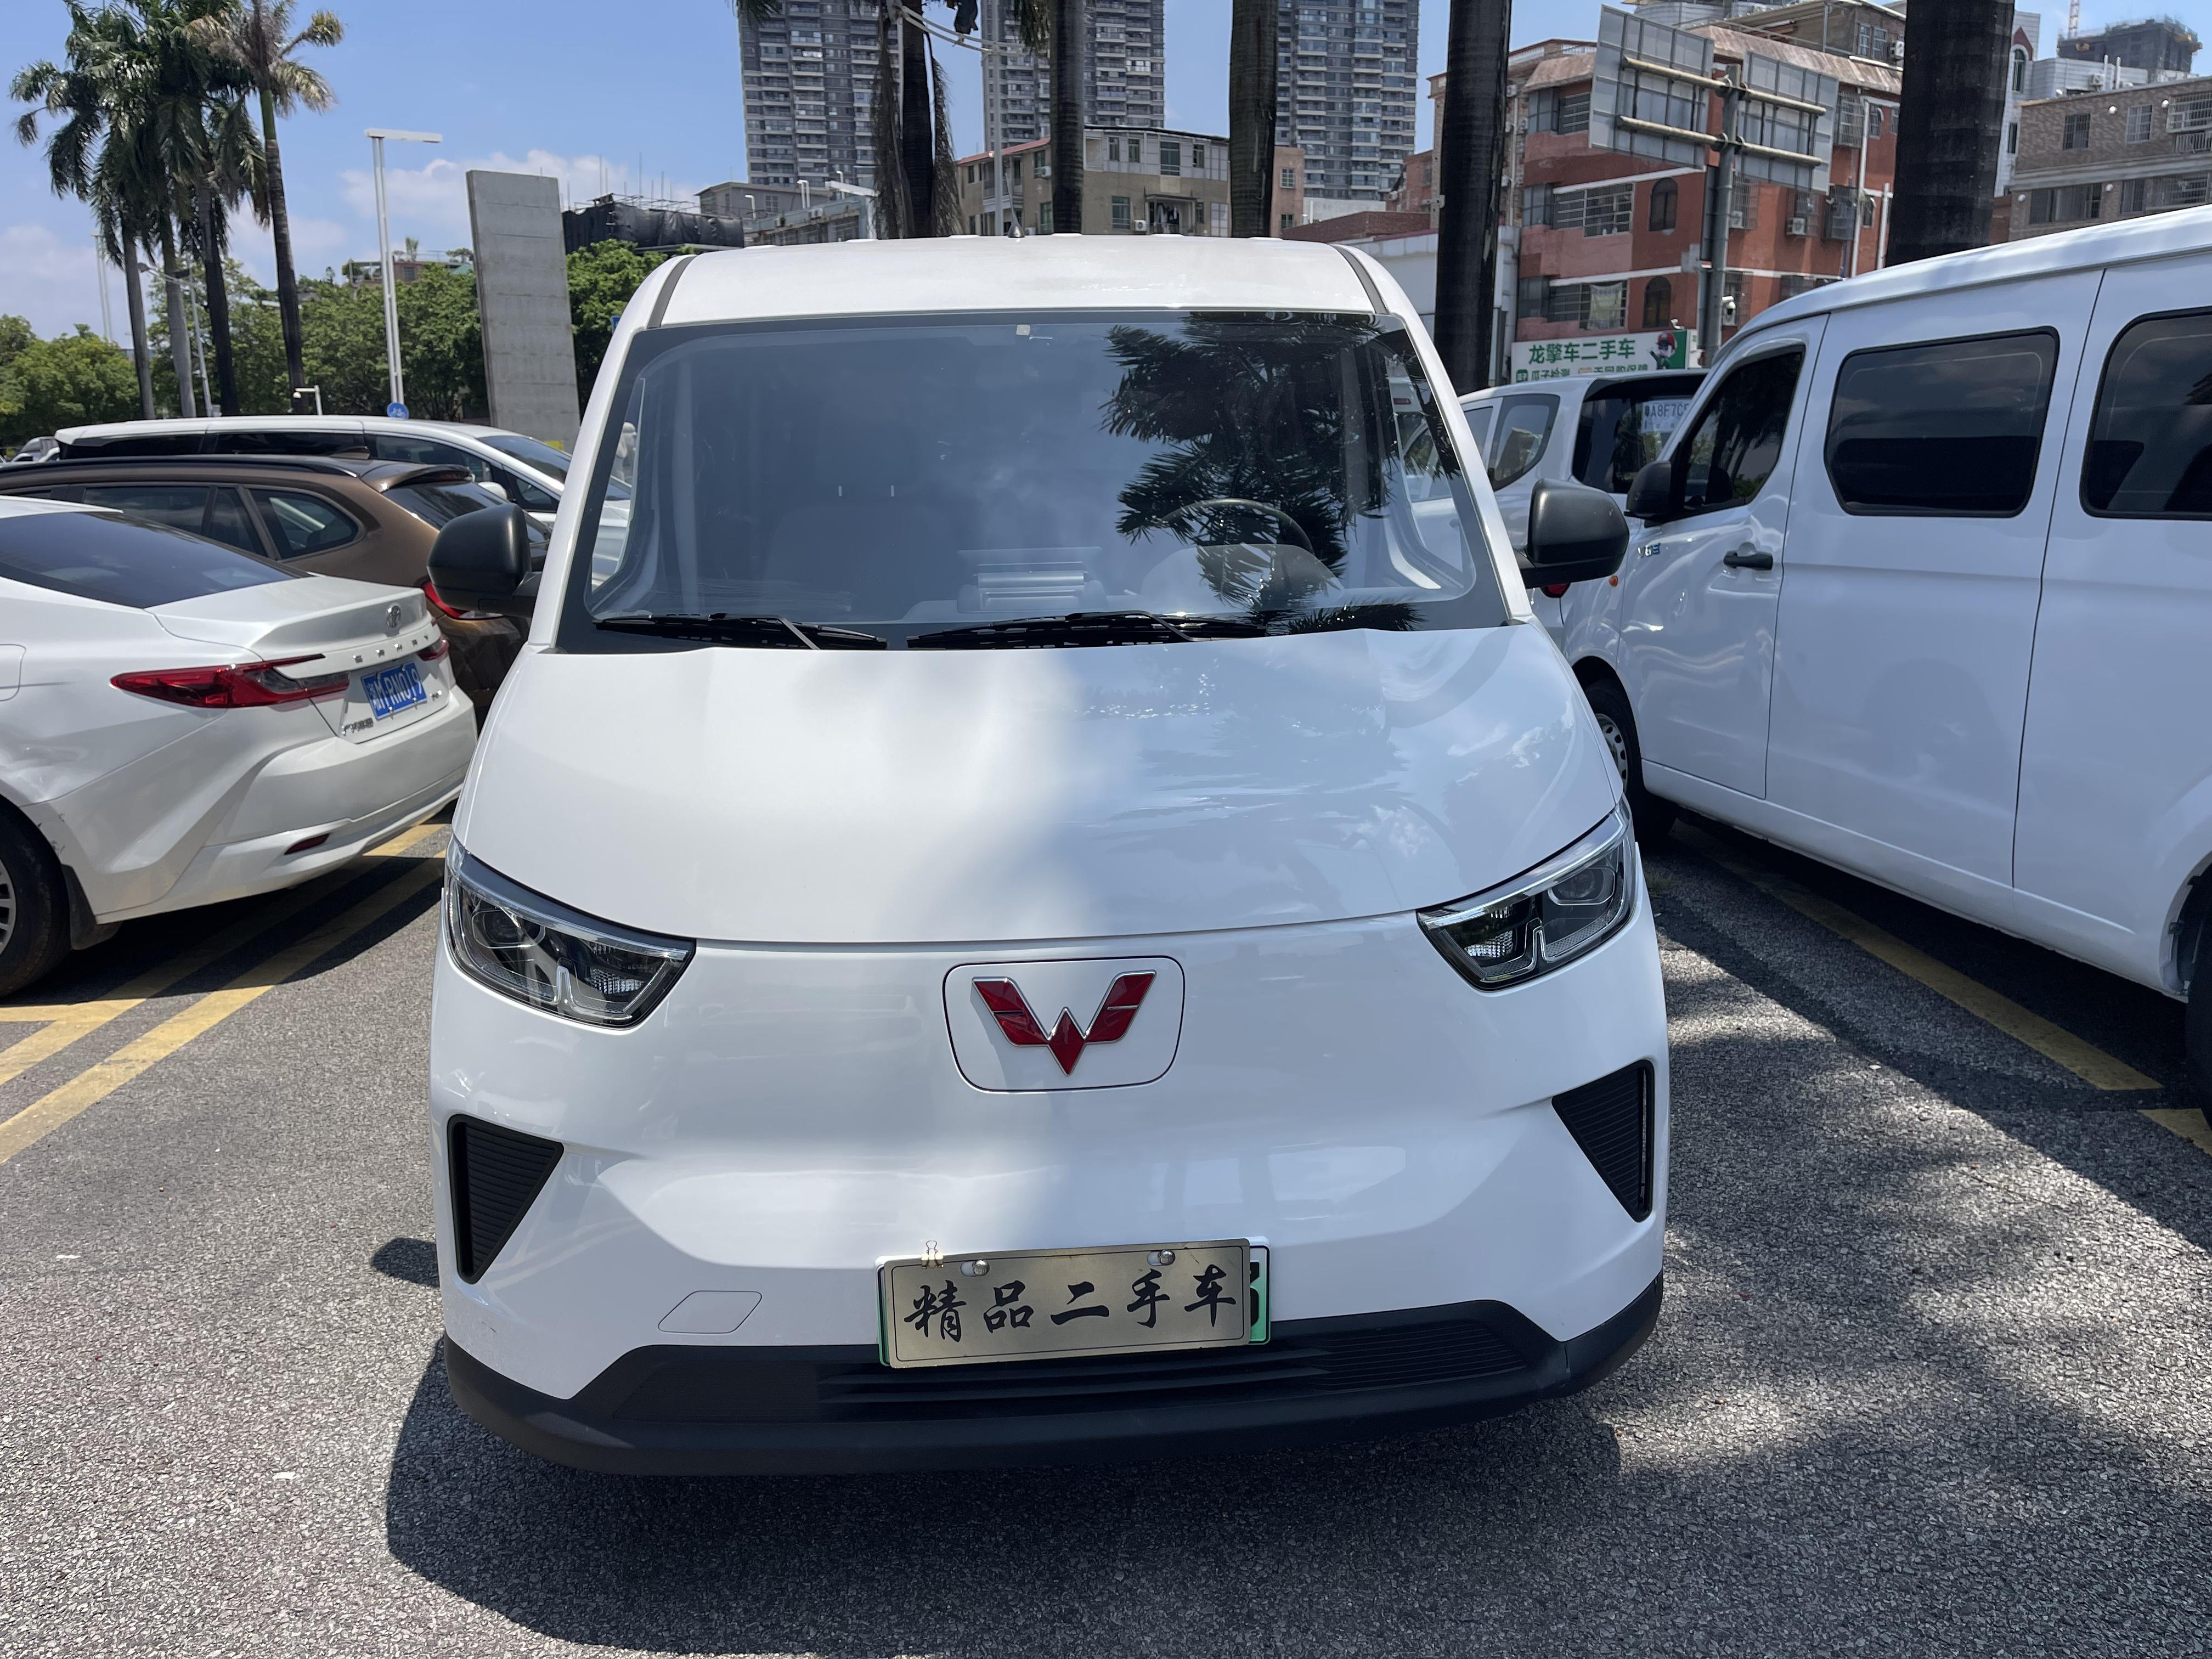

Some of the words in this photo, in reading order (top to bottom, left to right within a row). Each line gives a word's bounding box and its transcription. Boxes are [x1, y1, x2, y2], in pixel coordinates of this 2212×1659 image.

[1528, 338, 1635, 365] 龙擎车二手车
[904, 1264, 1237, 1342] 精品二手车
